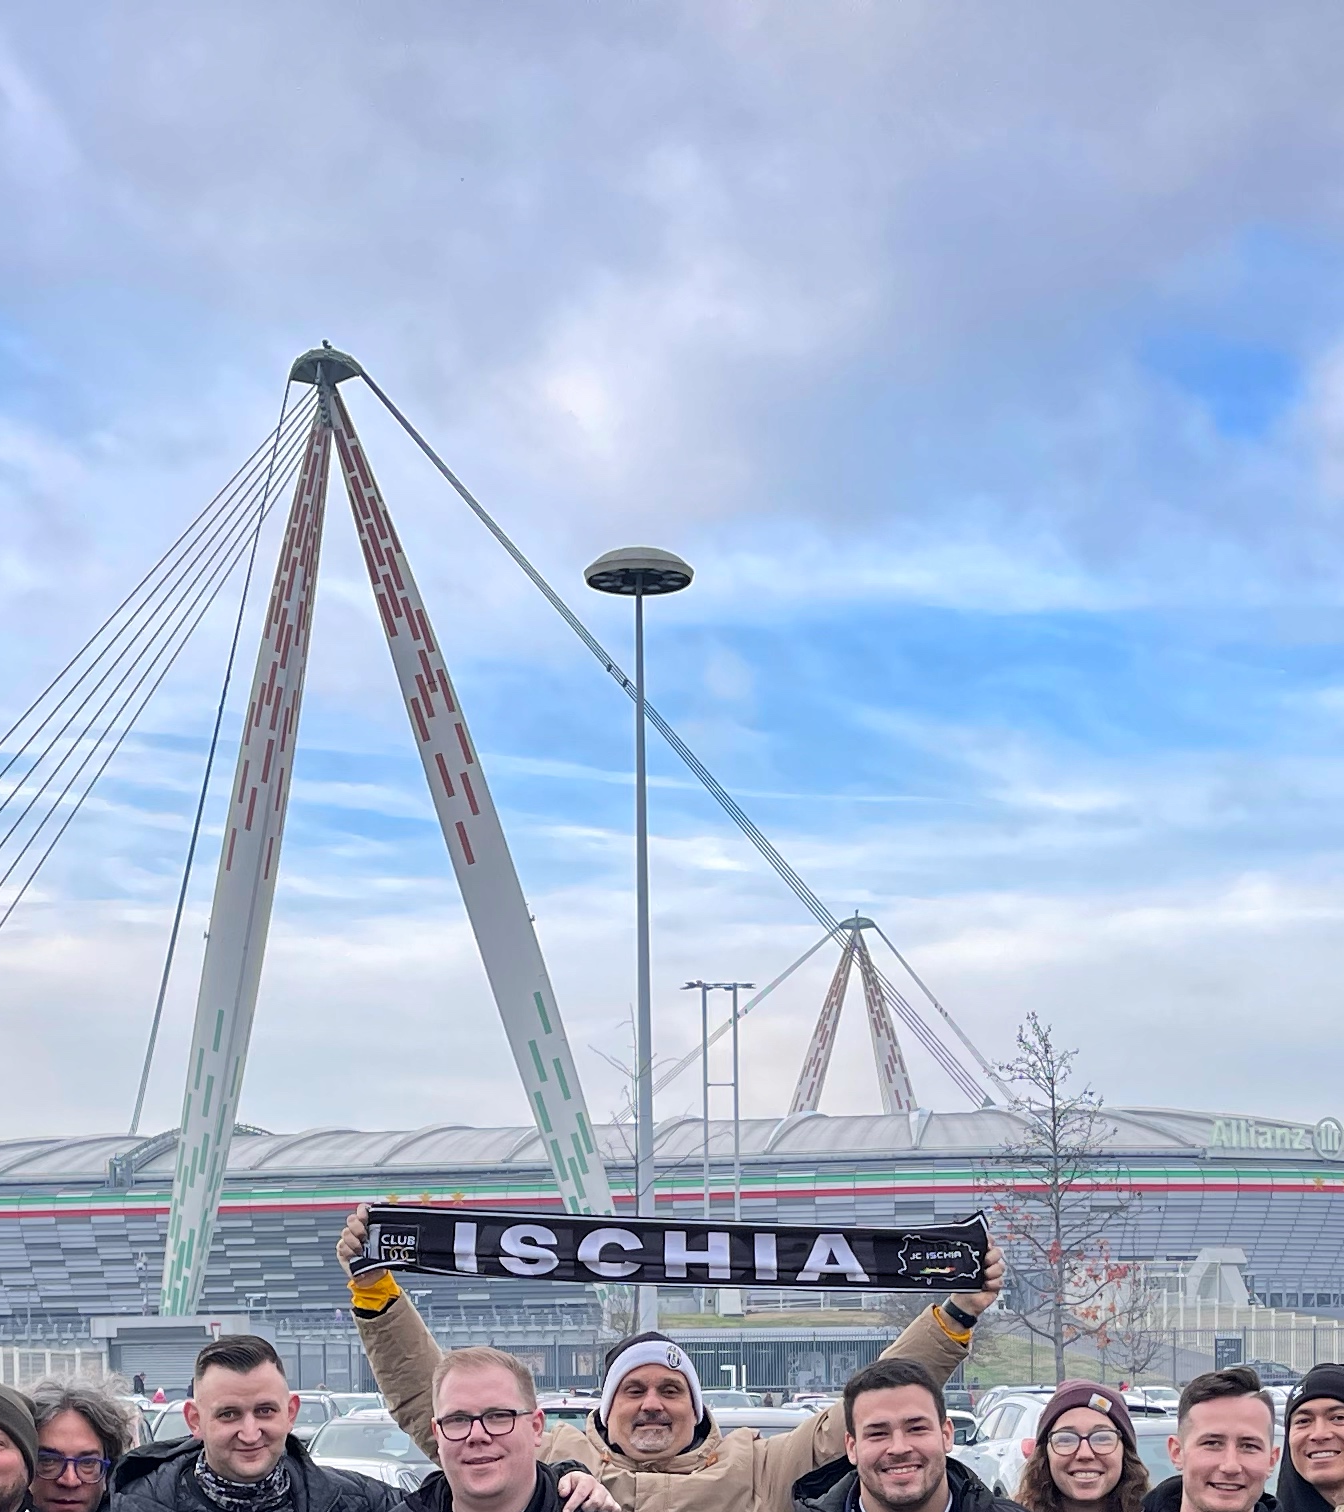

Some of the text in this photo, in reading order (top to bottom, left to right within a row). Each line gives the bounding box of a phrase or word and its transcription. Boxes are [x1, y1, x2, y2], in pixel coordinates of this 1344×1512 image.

[1209, 1118, 1307, 1150] Allianz
[380, 1233, 417, 1247] CLUB
[453, 1221, 871, 1282] ISCHIA
[925, 1250, 962, 1260] ISCHIA
